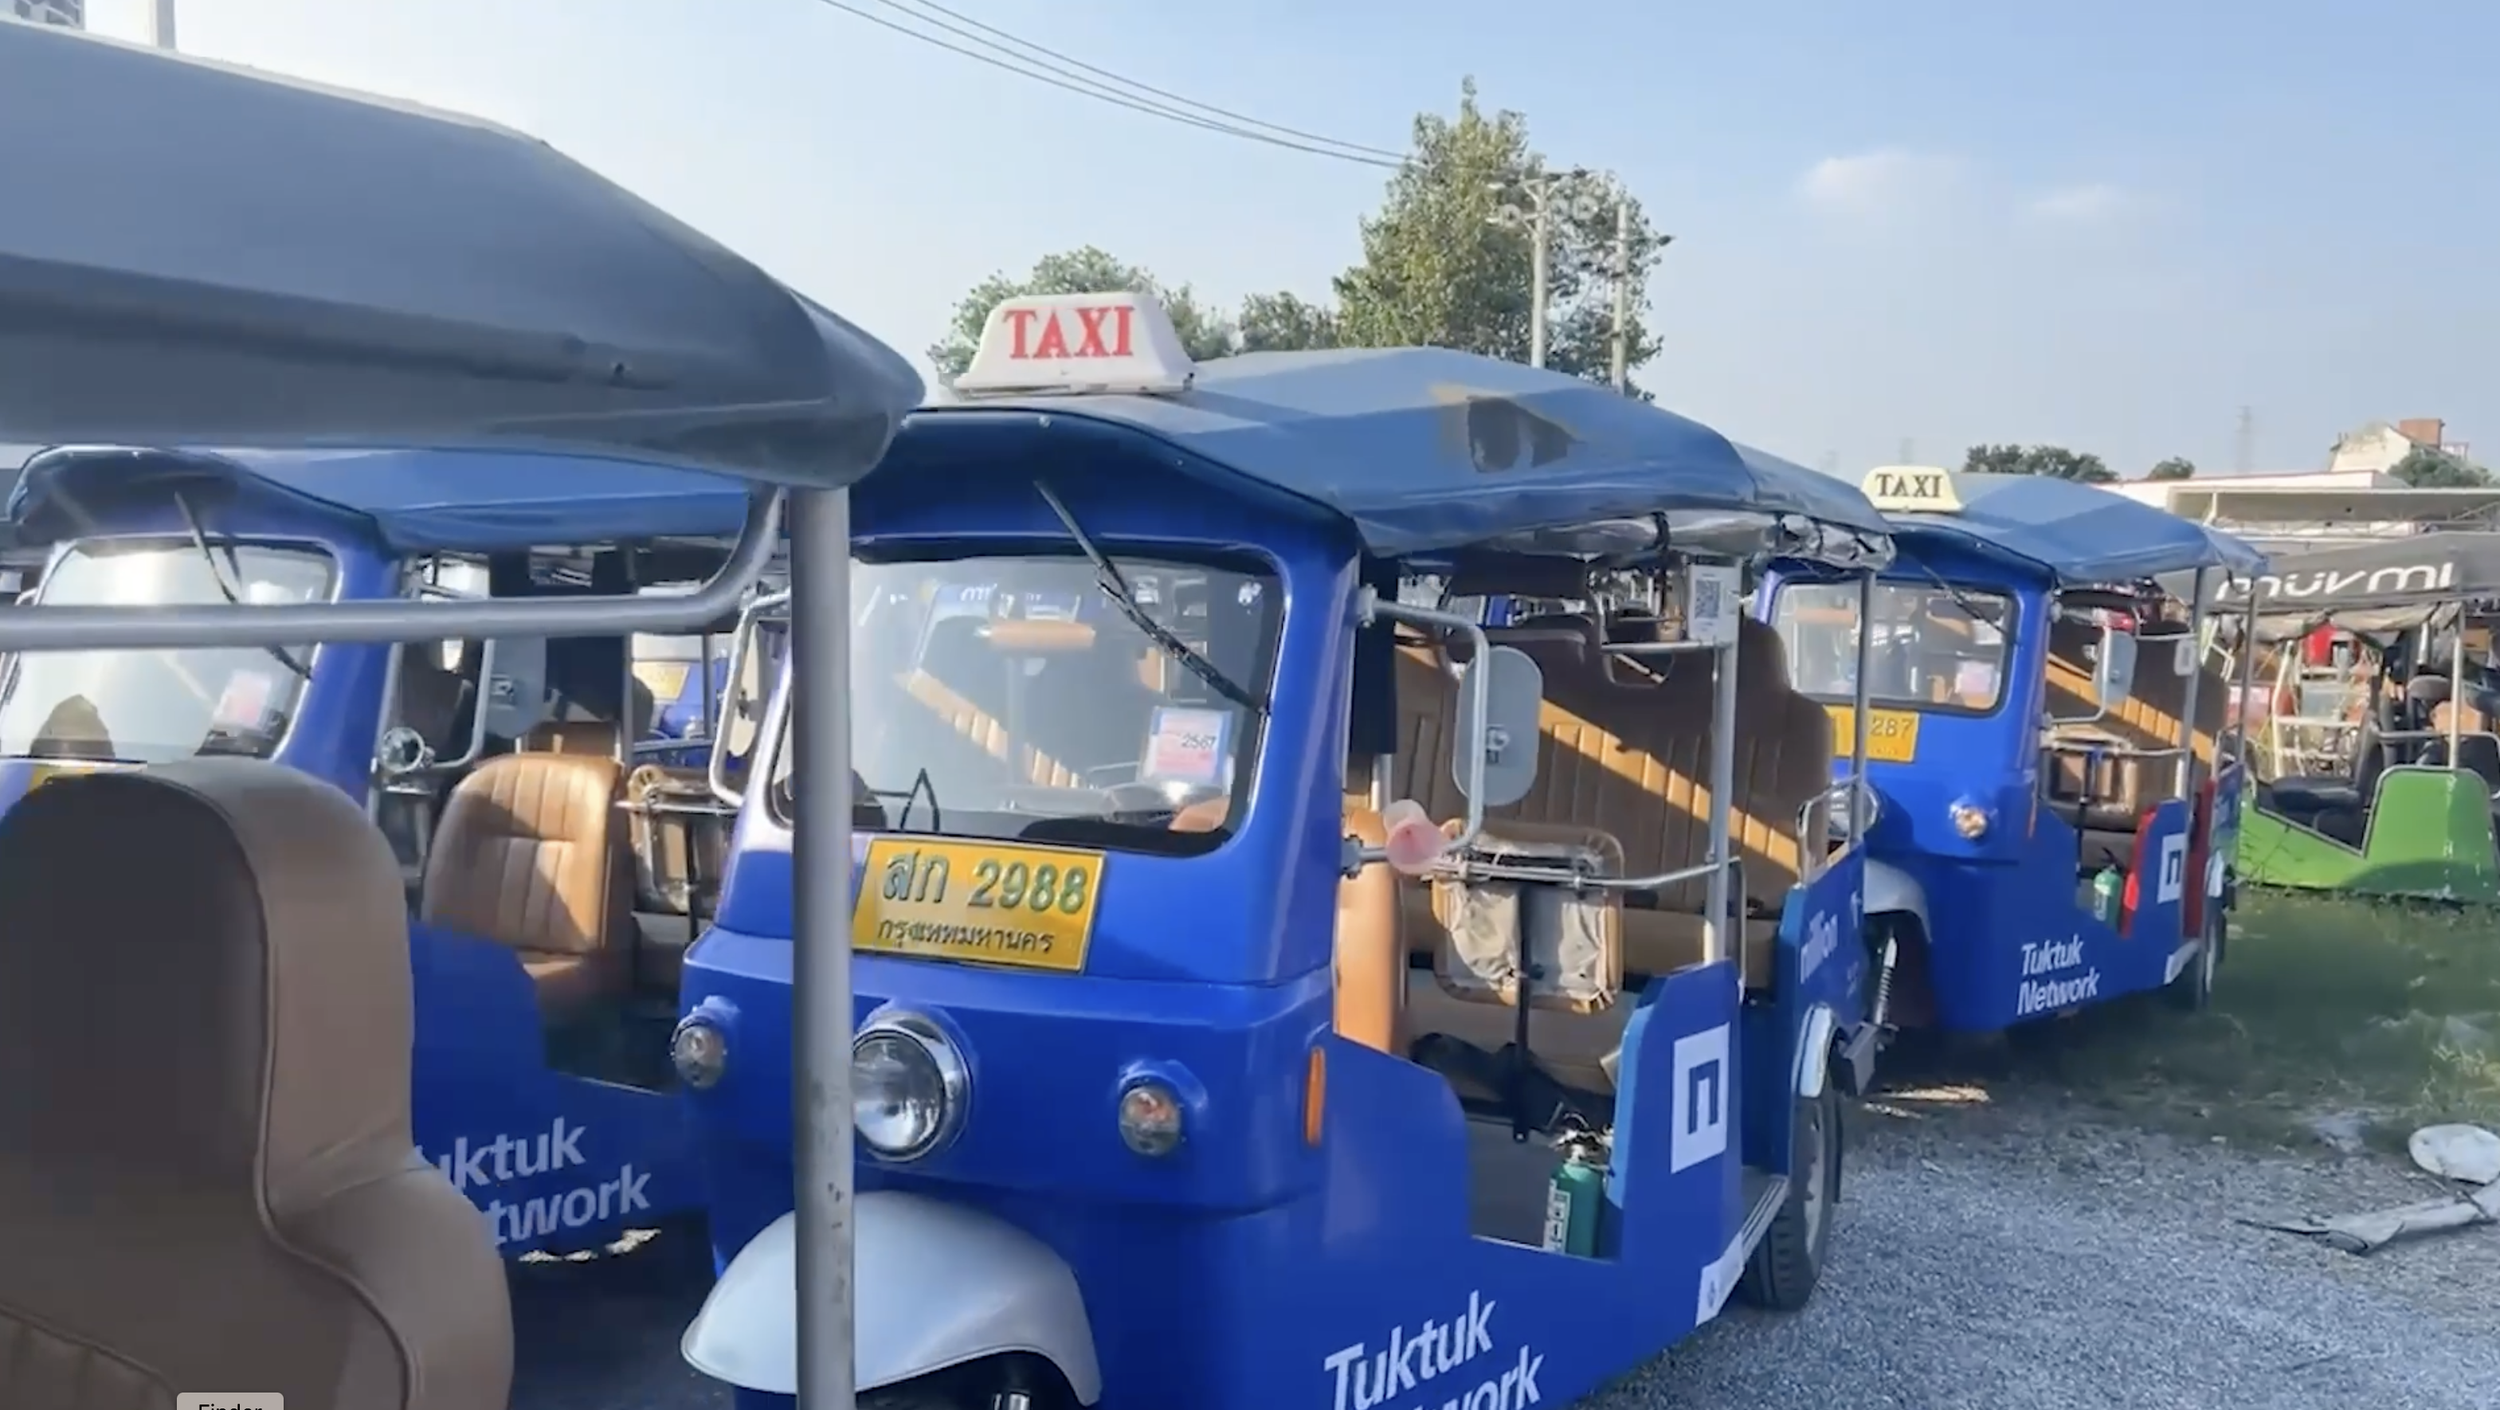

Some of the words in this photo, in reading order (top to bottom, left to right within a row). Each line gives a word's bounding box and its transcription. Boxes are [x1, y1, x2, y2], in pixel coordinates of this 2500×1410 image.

[1002, 305, 1135, 360] TAXI
[1874, 473, 1944, 498] TAXI
[967, 859, 1088, 915] 2988
[2021, 933, 2084, 976] Tuktuk
[2017, 966, 2100, 1016] Network
[414, 1116, 587, 1192] ktuk
[484, 1163, 652, 1244] twork
[1324, 1290, 1496, 1410] Tuktuk
